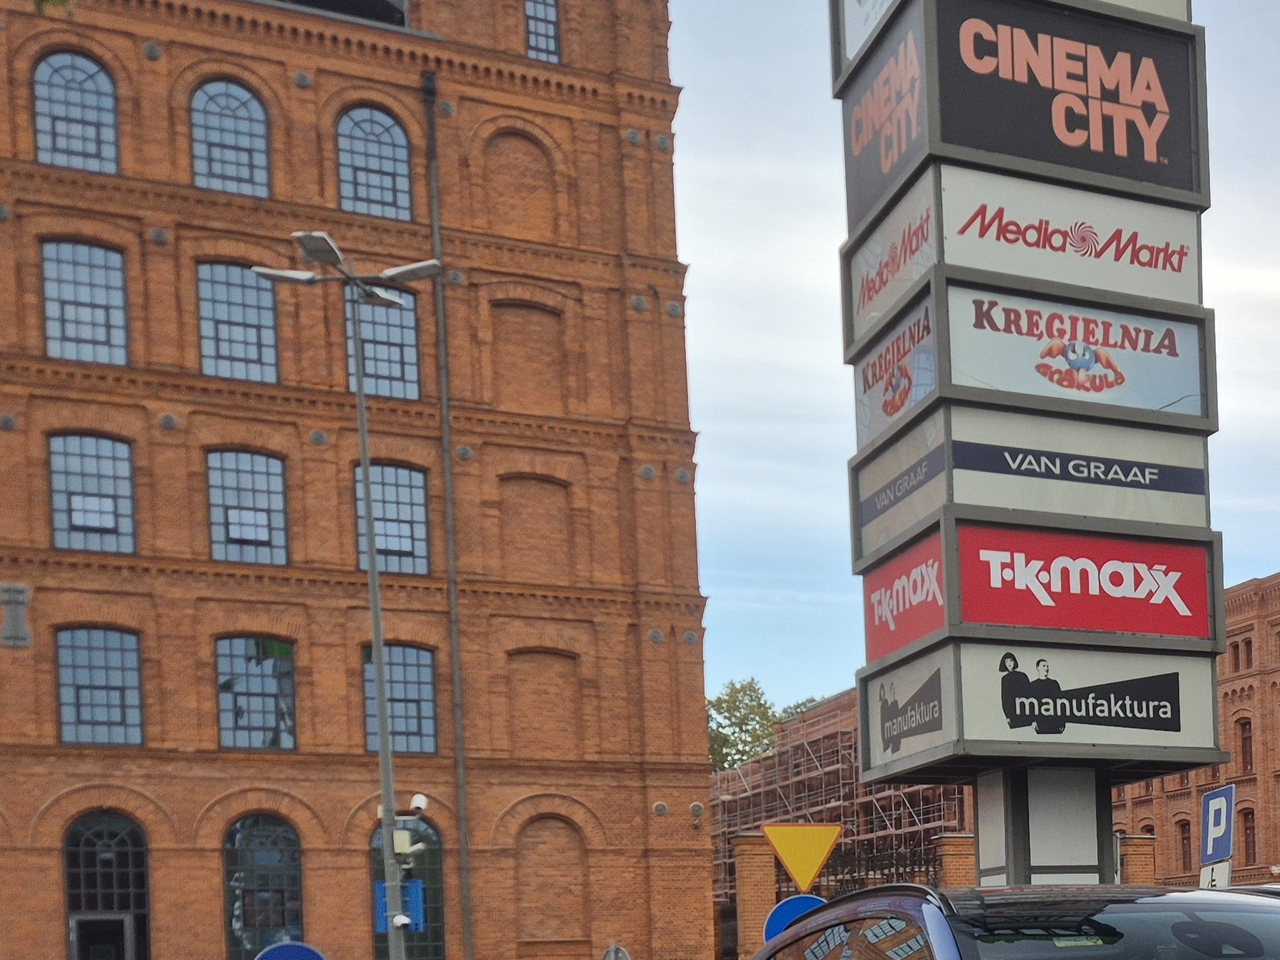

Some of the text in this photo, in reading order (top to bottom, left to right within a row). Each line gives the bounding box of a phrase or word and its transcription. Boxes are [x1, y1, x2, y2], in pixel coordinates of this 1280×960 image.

[851, 31, 920, 156] CINEMA
[958, 18, 1170, 114] CINEMA
[881, 77, 921, 174] CITY
[1051, 92, 1170, 163] CITY
[972, 299, 1180, 358] KRĘGIELNIA
[875, 460, 928, 511] VAN GRAAF
[1003, 451, 1160, 485] VAN GRAAF
[884, 700, 940, 740] manufaktura
[1014, 693, 1172, 720] manufaktura
[1206, 796, 1227, 856] P
